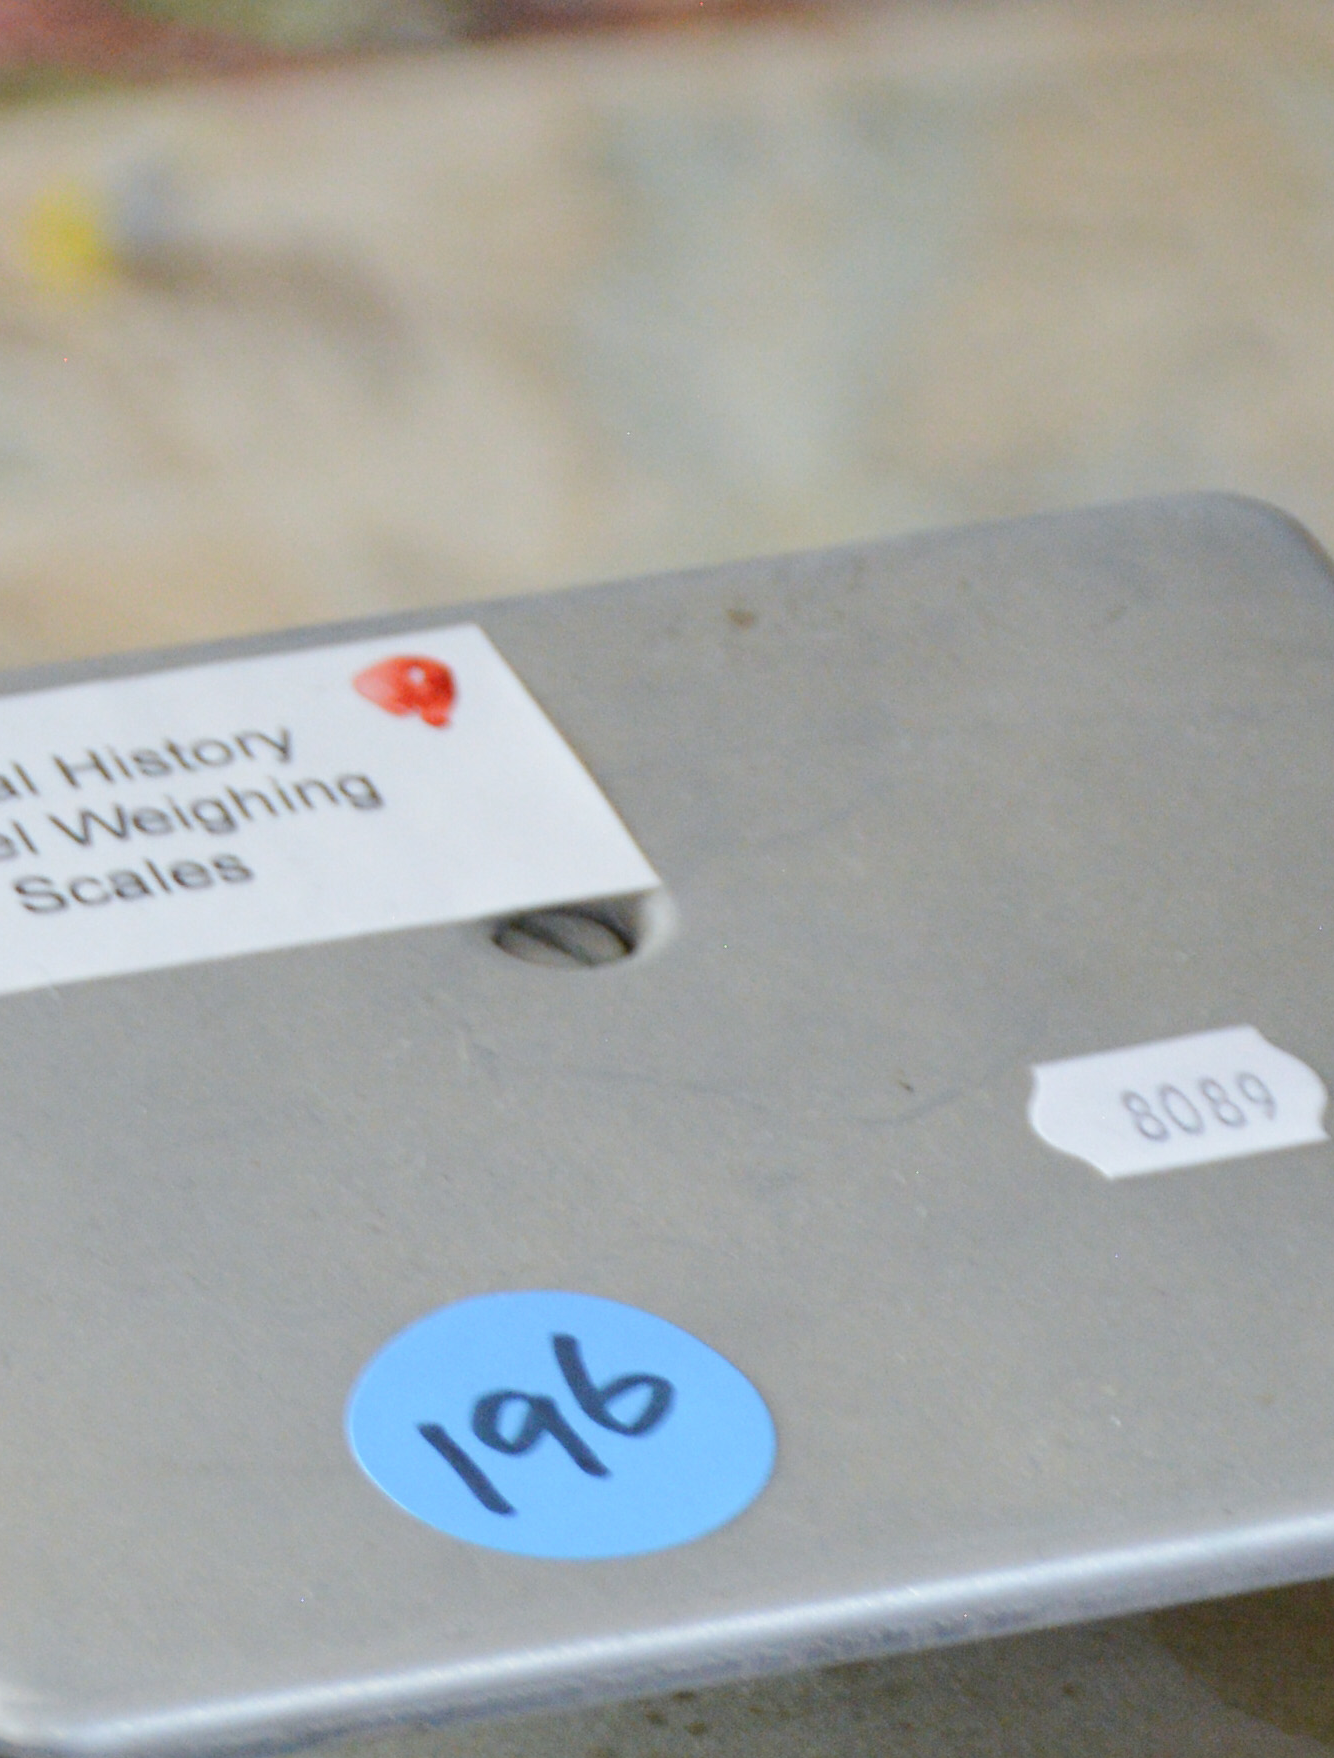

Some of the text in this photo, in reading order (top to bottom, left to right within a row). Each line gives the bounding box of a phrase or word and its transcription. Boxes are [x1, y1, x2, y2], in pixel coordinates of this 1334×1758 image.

[52, 727, 295, 791] History
[48, 772, 386, 849] Weighing
[11, 853, 255, 916] Scales
[1119, 1071, 1276, 1144] 8089
[418, 1333, 674, 1517] 196
